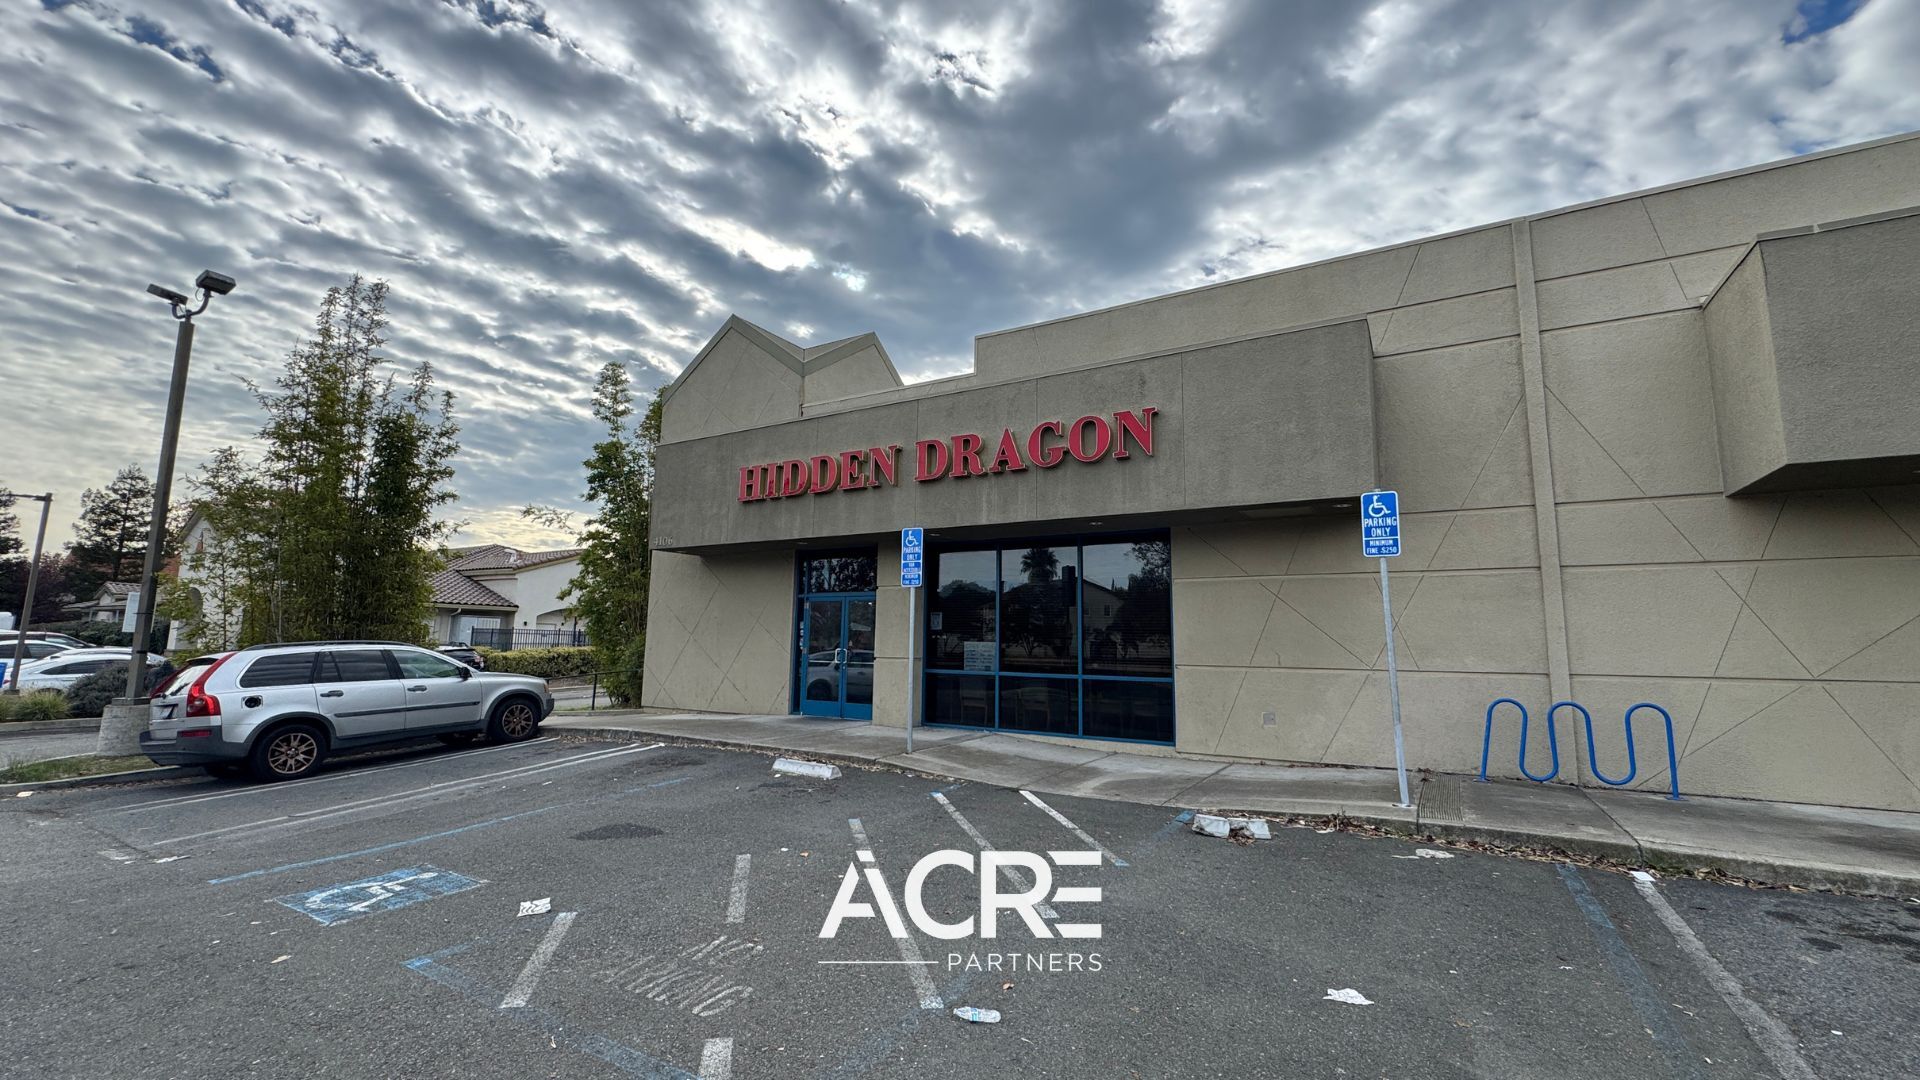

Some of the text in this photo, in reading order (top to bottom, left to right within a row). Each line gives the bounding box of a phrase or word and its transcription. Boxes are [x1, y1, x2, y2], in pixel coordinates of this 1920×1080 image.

[738, 406, 1158, 502] HIDDEN DRAGON
[1364, 516, 1397, 527] PARKING
[1371, 527, 1391, 537] ONLY
[1369, 539, 1393, 547] MINIMUM
[1366, 547, 1379, 555] FINE
